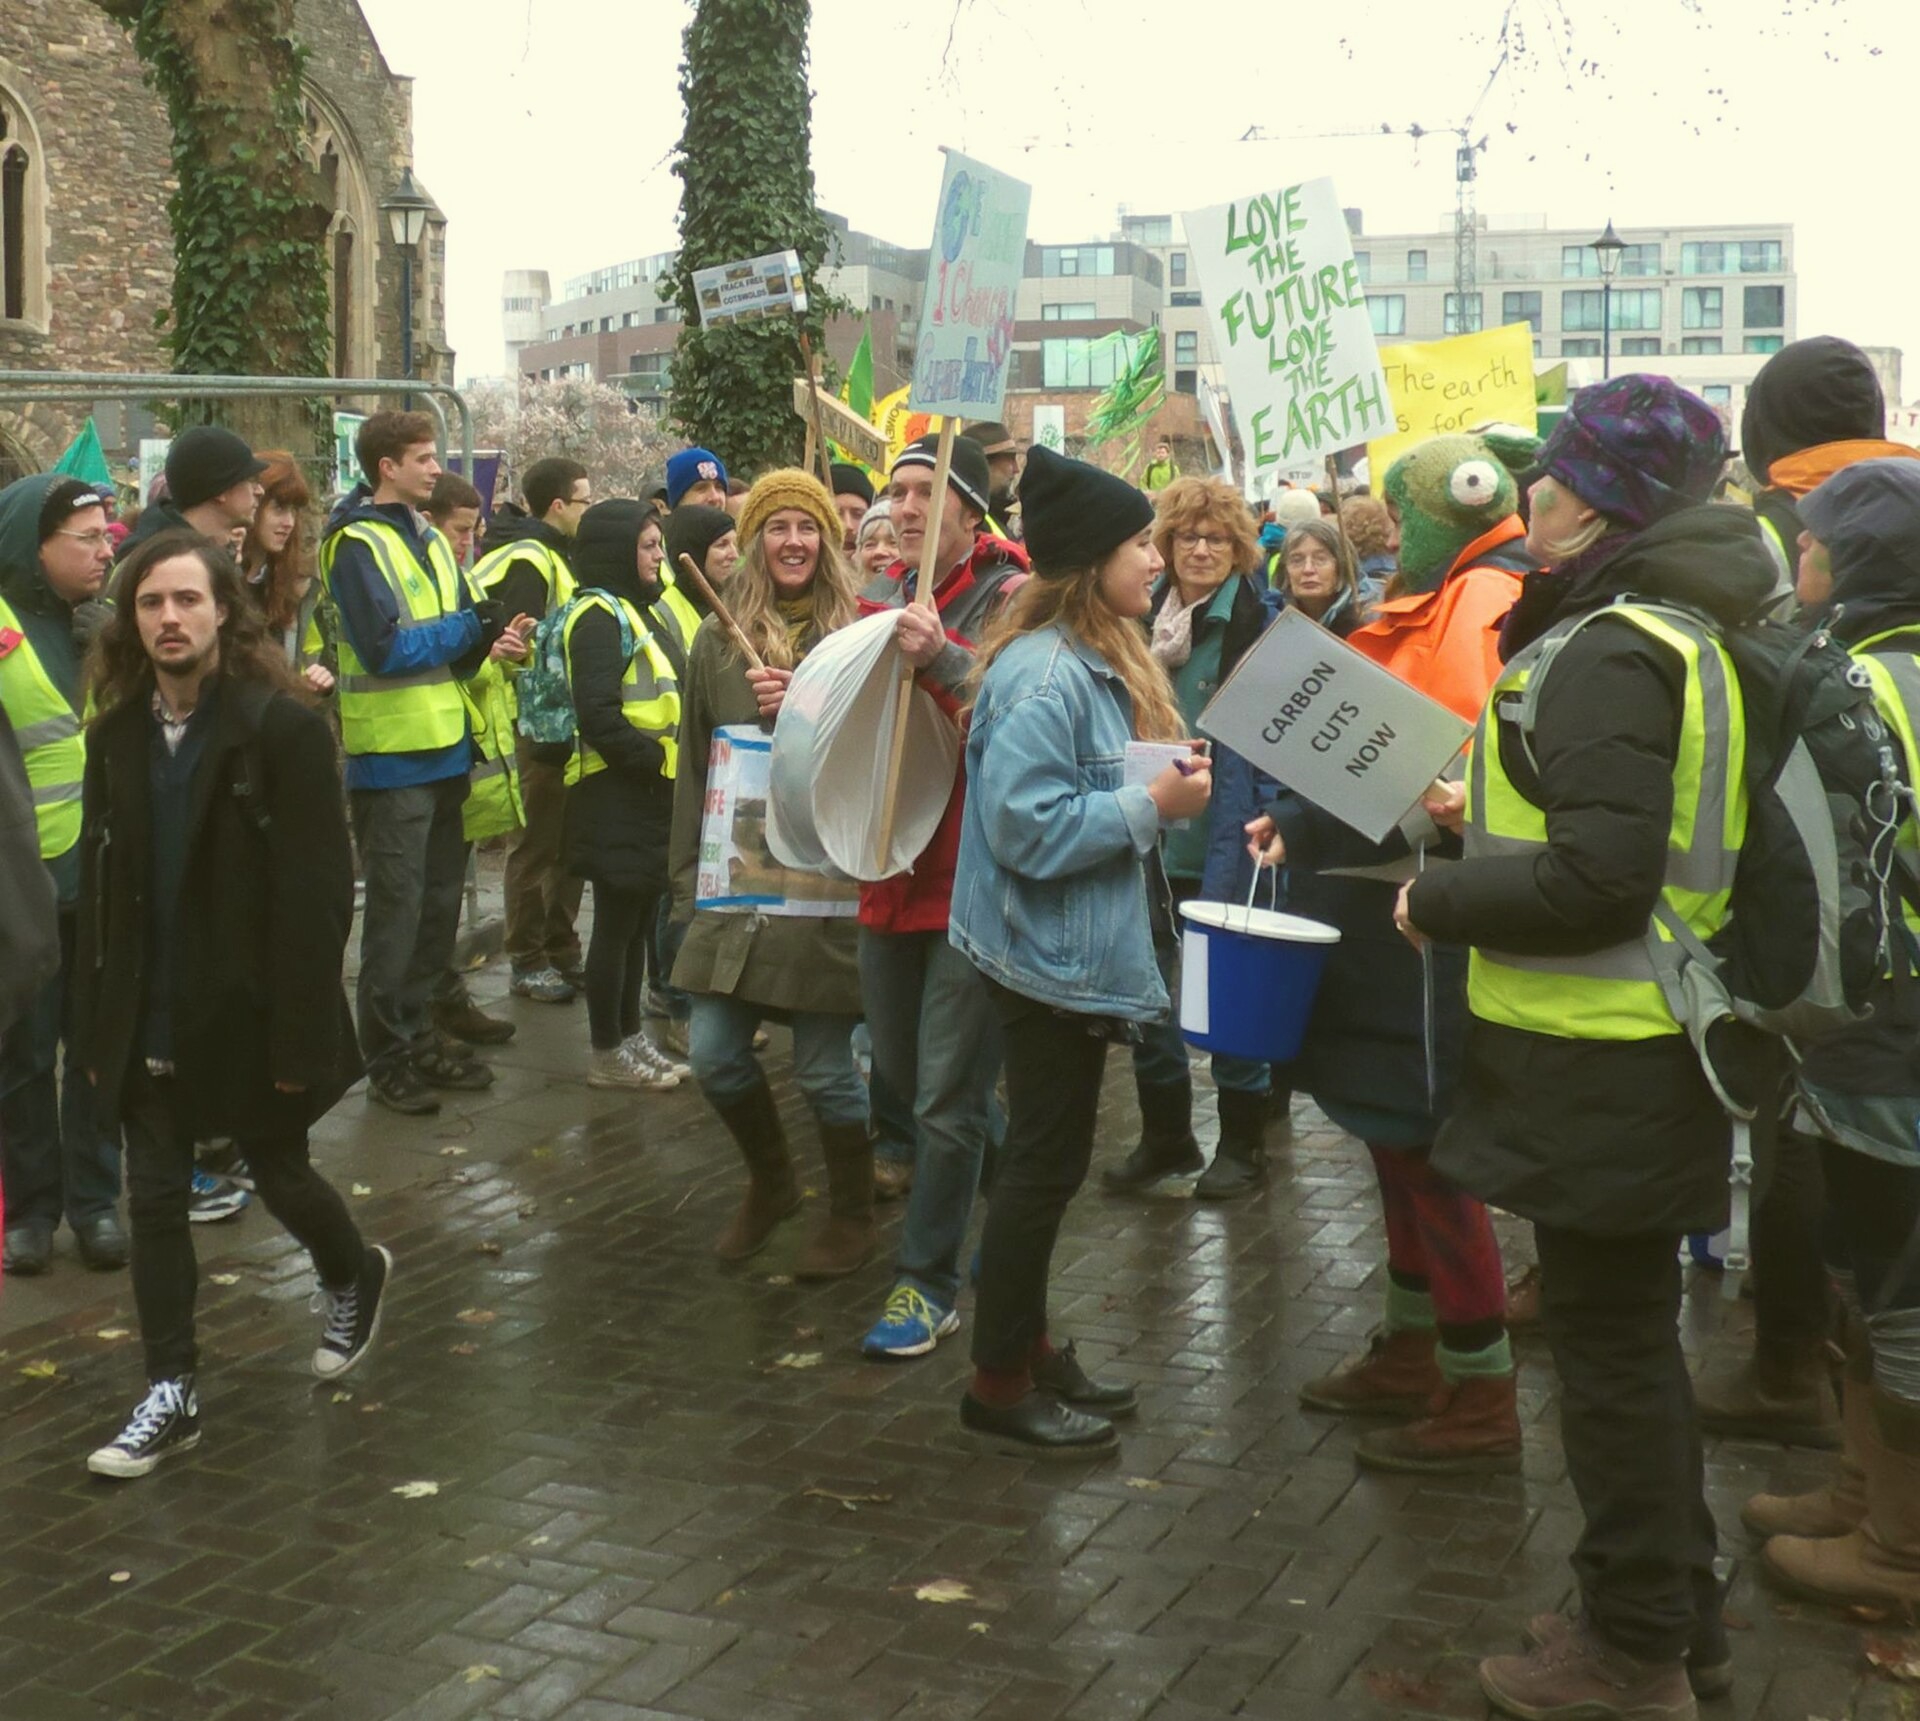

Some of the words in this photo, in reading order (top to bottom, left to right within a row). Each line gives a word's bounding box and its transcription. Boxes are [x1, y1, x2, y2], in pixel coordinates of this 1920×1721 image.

[1226, 184, 1308, 255] LOVE
[1248, 239, 1305, 285] THE
[1220, 259, 1366, 346] FUTURE
[1268, 316, 1337, 374] LOVE
[1284, 354, 1333, 397] THE
[1382, 363, 1435, 393] The
[1443, 356, 1518, 400] earth
[1251, 372, 1386, 468] EARTH
[1428, 407, 1474, 434] for
[1261, 661, 1336, 744] CARBON
[1310, 701, 1360, 753] CUTS
[1345, 722, 1396, 778] NOW
